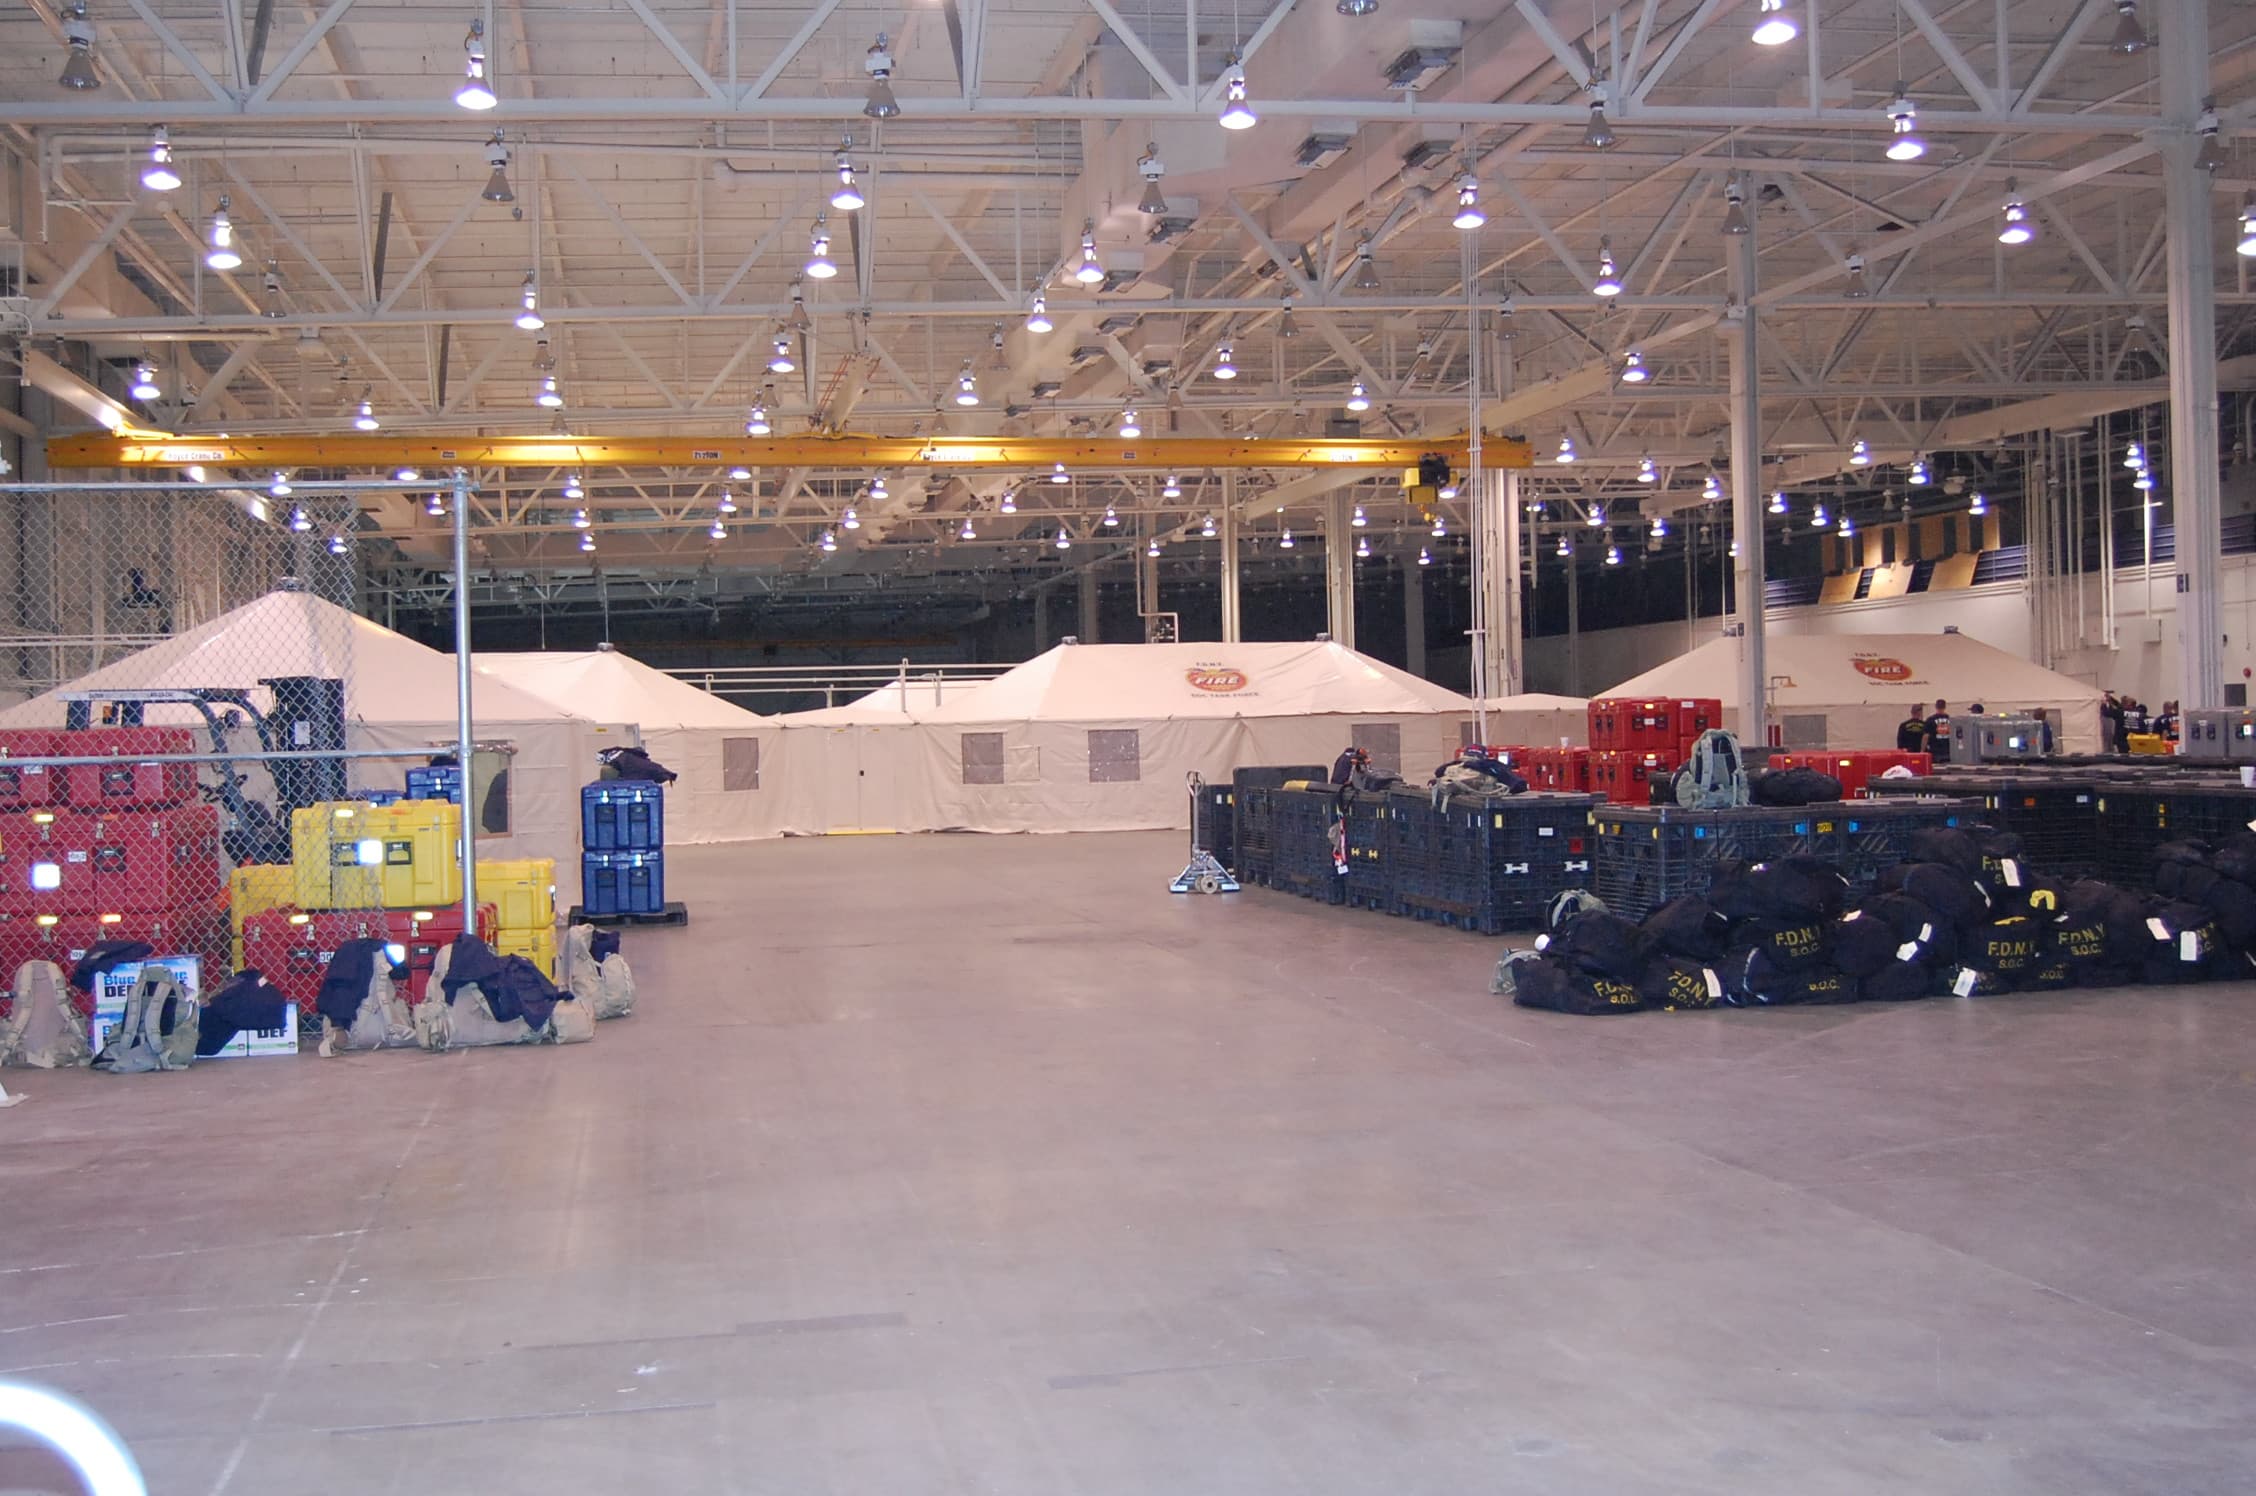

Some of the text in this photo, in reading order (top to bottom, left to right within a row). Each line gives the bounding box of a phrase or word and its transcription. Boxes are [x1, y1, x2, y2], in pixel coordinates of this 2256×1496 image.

[1865, 666, 1903, 674] FIRE
[1195, 676, 1240, 685] FIRE
[104, 975, 136, 986] Blue
